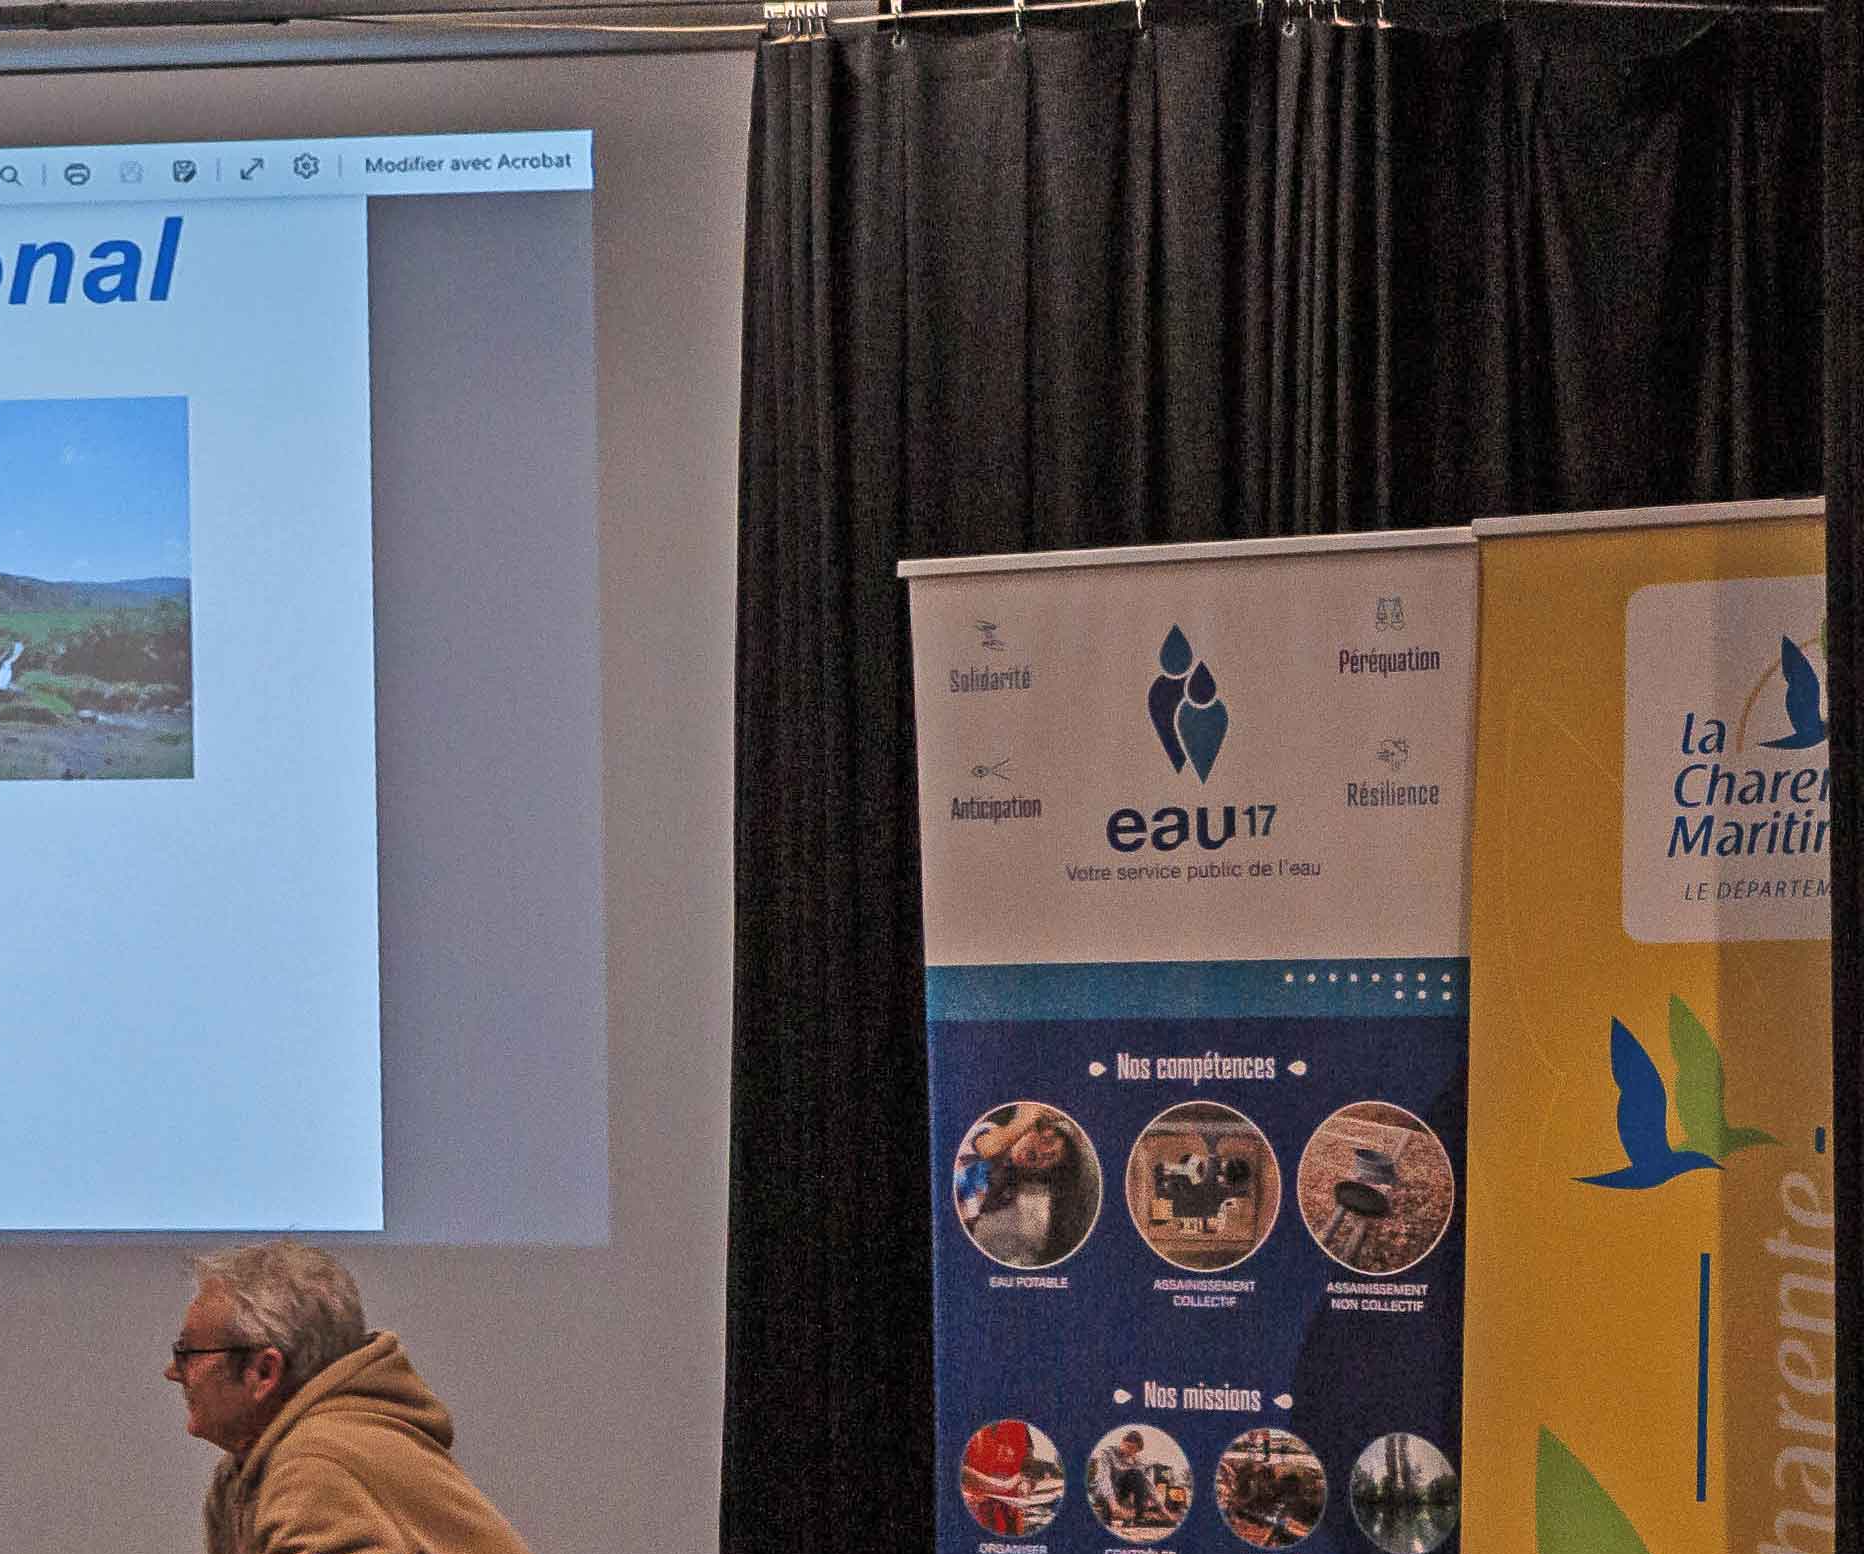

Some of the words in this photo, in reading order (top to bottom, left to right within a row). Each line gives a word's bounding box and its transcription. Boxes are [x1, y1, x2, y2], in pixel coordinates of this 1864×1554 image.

[365, 156, 443, 174] Modifier
[450, 157, 493, 172] avec
[498, 153, 571, 170] Acrobat
[1338, 645, 1440, 678] Péréquation
[949, 668, 1032, 694] Solidarité
[1682, 712, 1726, 754] la
[1347, 782, 1440, 808] Résilience
[951, 795, 1041, 825] Anticipation
[1066, 864, 1111, 882] Votre
[1117, 865, 1181, 881] service
[1187, 862, 1242, 884] public
[1249, 862, 1273, 878] de
[1279, 860, 1321, 878] l'eau
[1685, 882, 1708, 900] LE
[1117, 1053, 1151, 1081] Nos
[1156, 1050, 1276, 1087] compétences
[990, 1278, 1013, 1288] EAU
[1016, 1277, 1069, 1289] POTABLE
[1153, 1279, 1256, 1293] ASSAINISSEMENT
[1327, 1283, 1429, 1296] ASSAINISSEMENT
[1173, 1295, 1238, 1307] COLLECTIF
[1332, 1299, 1359, 1311] NON
[1362, 1299, 1425, 1312] COLLECTIF
[1144, 1381, 1179, 1409] Nos
[1183, 1382, 1262, 1413] missions
